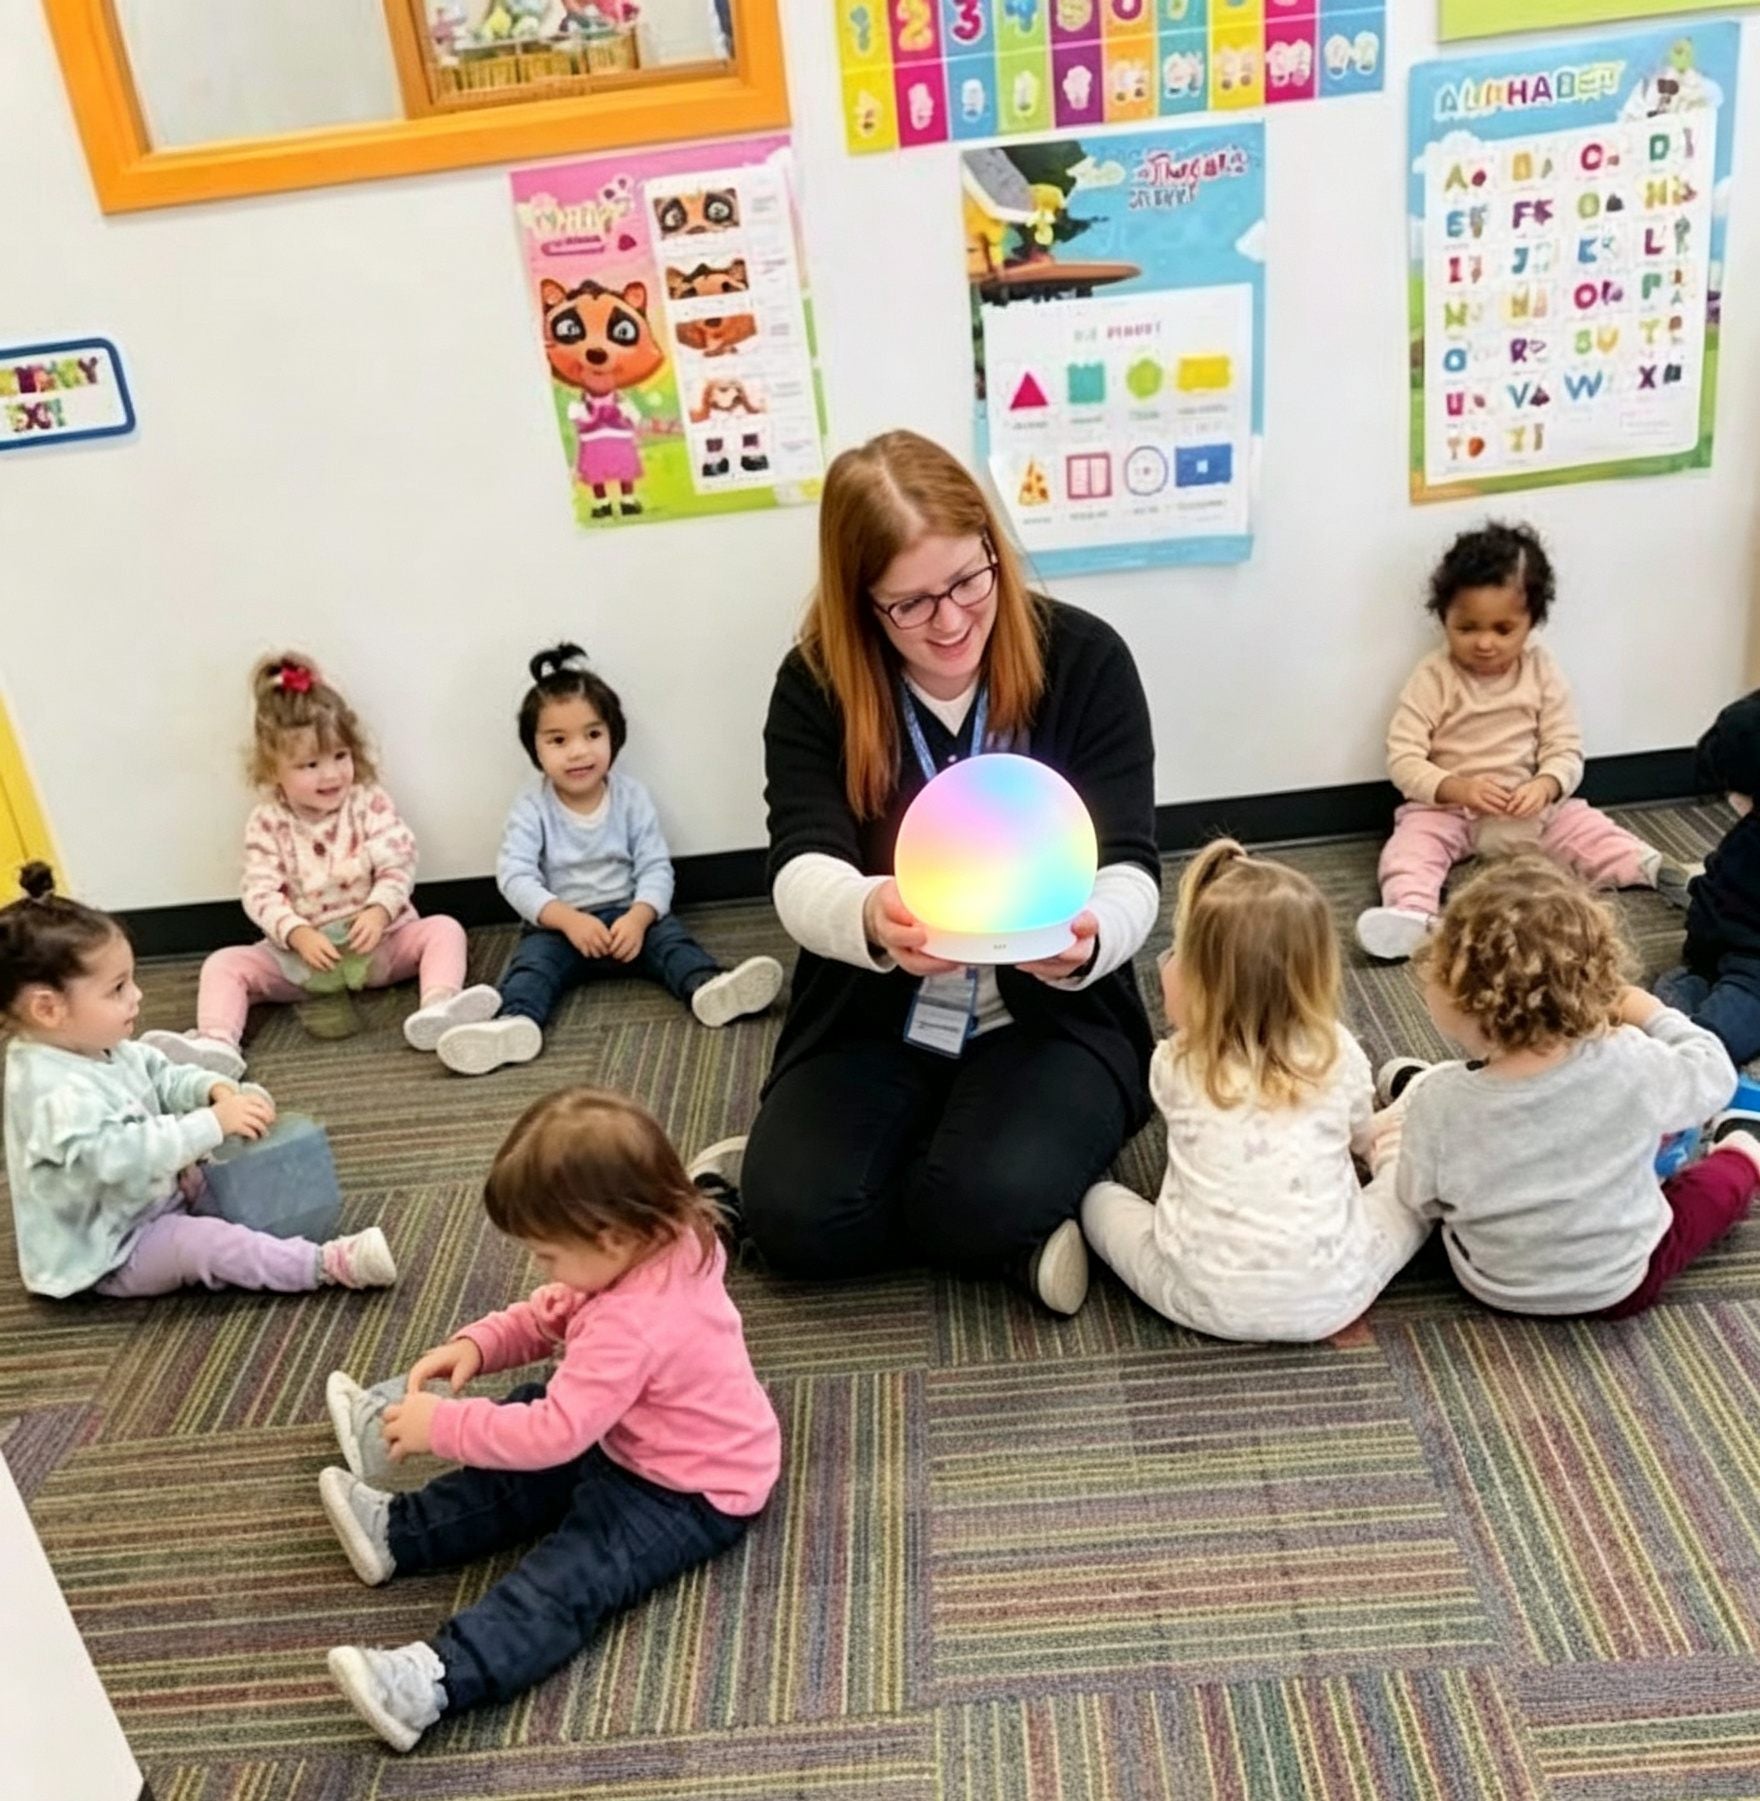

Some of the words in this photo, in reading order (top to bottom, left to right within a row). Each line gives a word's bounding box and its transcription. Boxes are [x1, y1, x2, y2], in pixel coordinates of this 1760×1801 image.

[896, 0, 934, 50] 2
[952, 0, 983, 41] 3
[1444, 163, 1468, 192] A
[1580, 143, 1603, 171] C
[1649, 134, 1670, 162] D
[1447, 210, 1465, 237] E
[1512, 201, 1533, 229] F
[1511, 247, 1529, 274] J
[1645, 228, 1665, 255] L
[1574, 283, 1598, 310] O
[1642, 273, 1662, 300] P
[1510, 338, 1528, 363] R
[1446, 392, 1464, 416] U
[1506, 381, 1530, 409] V
[1564, 369, 1603, 401] W
[1638, 364, 1657, 389] X
